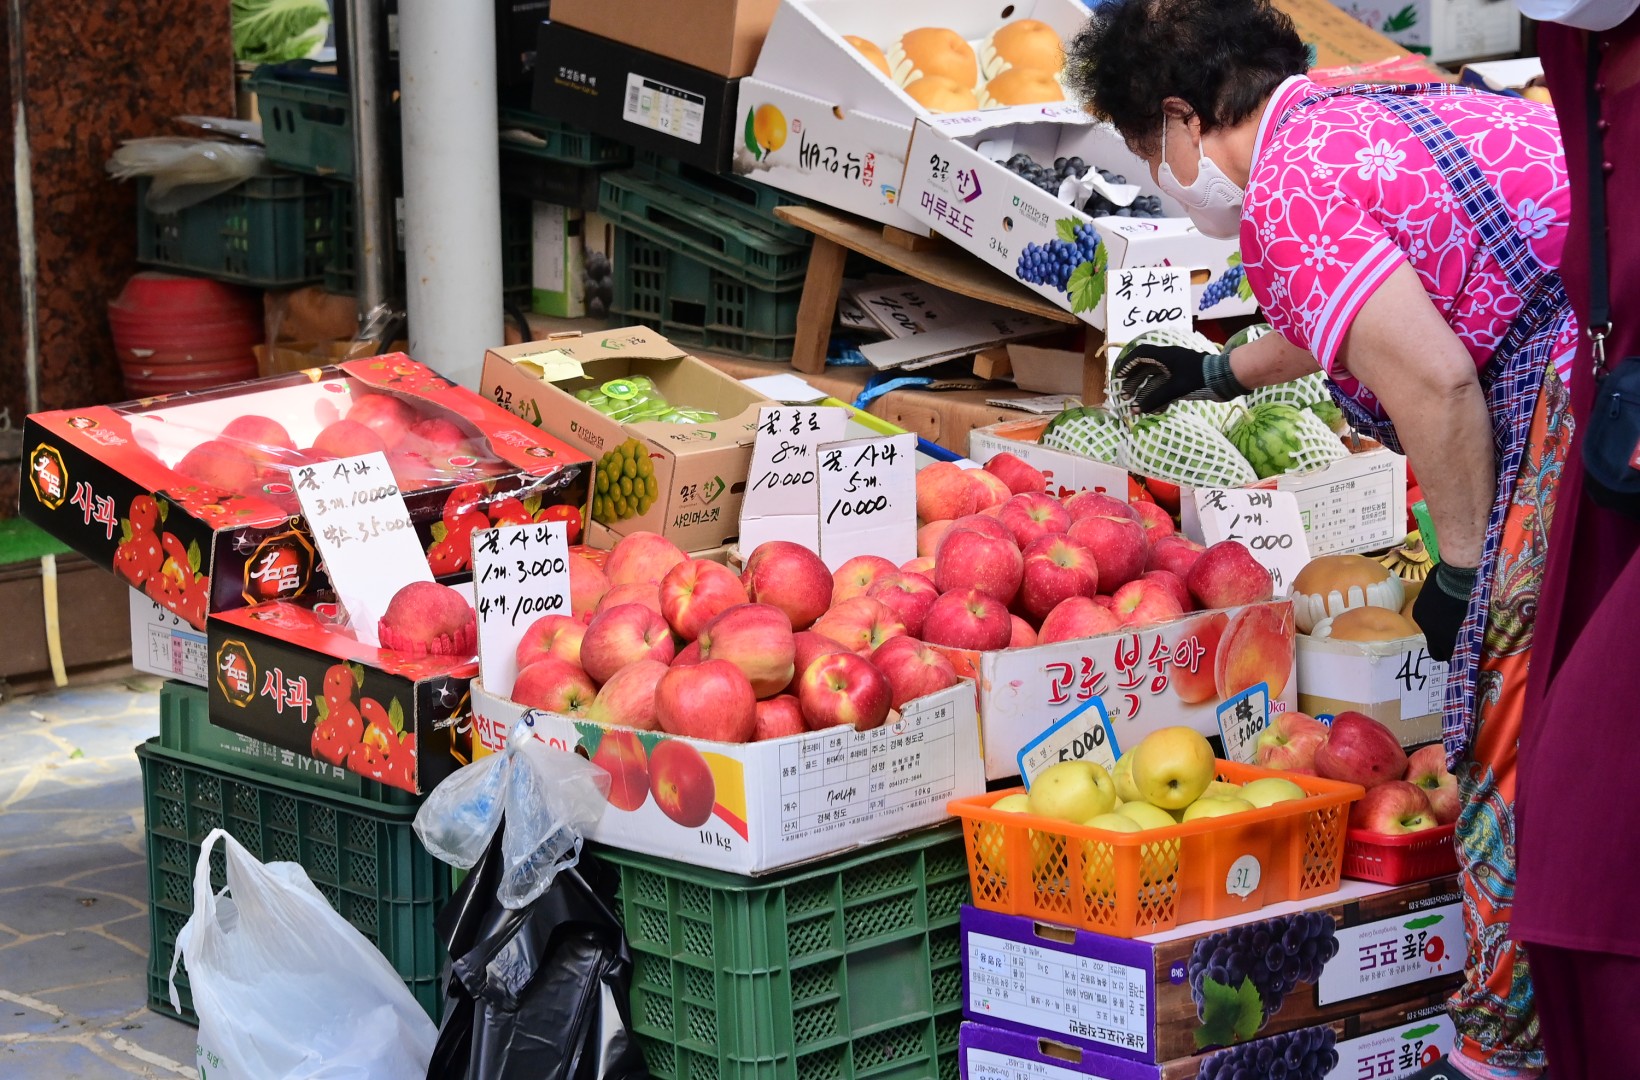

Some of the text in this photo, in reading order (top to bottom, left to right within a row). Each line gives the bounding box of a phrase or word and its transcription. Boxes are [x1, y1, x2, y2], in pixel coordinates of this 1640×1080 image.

[660, 117, 668, 127] 12
[921, 191, 974, 238] 머루포도
[989, 237, 1008, 258] 3 kg
[1141, 271, 1183, 298] 수박.
[752, 471, 815, 491] 10.000
[1247, 493, 1272, 508] 배
[70, 481, 118, 540] 사과
[673, 507, 720, 529] 샤인머스켓
[1115, 633, 1205, 719] 복숭아
[260, 668, 312, 724] 사과
[915, 716, 922, 726] 상
[934, 710, 946, 719] 보통
[1239, 716, 1263, 747] 5.000
[871, 743, 886, 754] 주소
[905, 733, 924, 746] 청도군
[782, 765, 797, 777] 품종
[871, 762, 885, 773] 성명
[871, 782, 885, 792] 전화
[870, 787, 931, 809] 무게 10kg
[783, 801, 798, 811] 개수
[784, 810, 847, 832] 산지 경북 청도
[699, 829, 732, 851] 10 kg
[1232, 868, 1252, 890] 3L
[1013, 956, 1025, 966] 전화
[1359, 939, 1398, 971] 포도
[1082, 959, 1088, 968] 년
[1093, 962, 1104, 970] 202
[1013, 968, 1025, 978] 이름
[1064, 970, 1076, 980] 무게
[1080, 973, 1095, 985] 영동군
[1013, 982, 1025, 991] 주소
[1096, 977, 1107, 988] 충북
[1112, 981, 1125, 991] 산지
[1079, 991, 1093, 999] MBA
[1128, 982, 1145, 999] 규격품
[1065, 1003, 1077, 1014] 등급
[1112, 997, 1125, 1010] 품종
[1095, 1010, 1108, 1019] 포도
[1112, 1014, 1125, 1025] 품목
[1068, 1020, 1145, 1050] 삼봉산포도작목반
[1357, 1049, 1395, 1080] 포도
